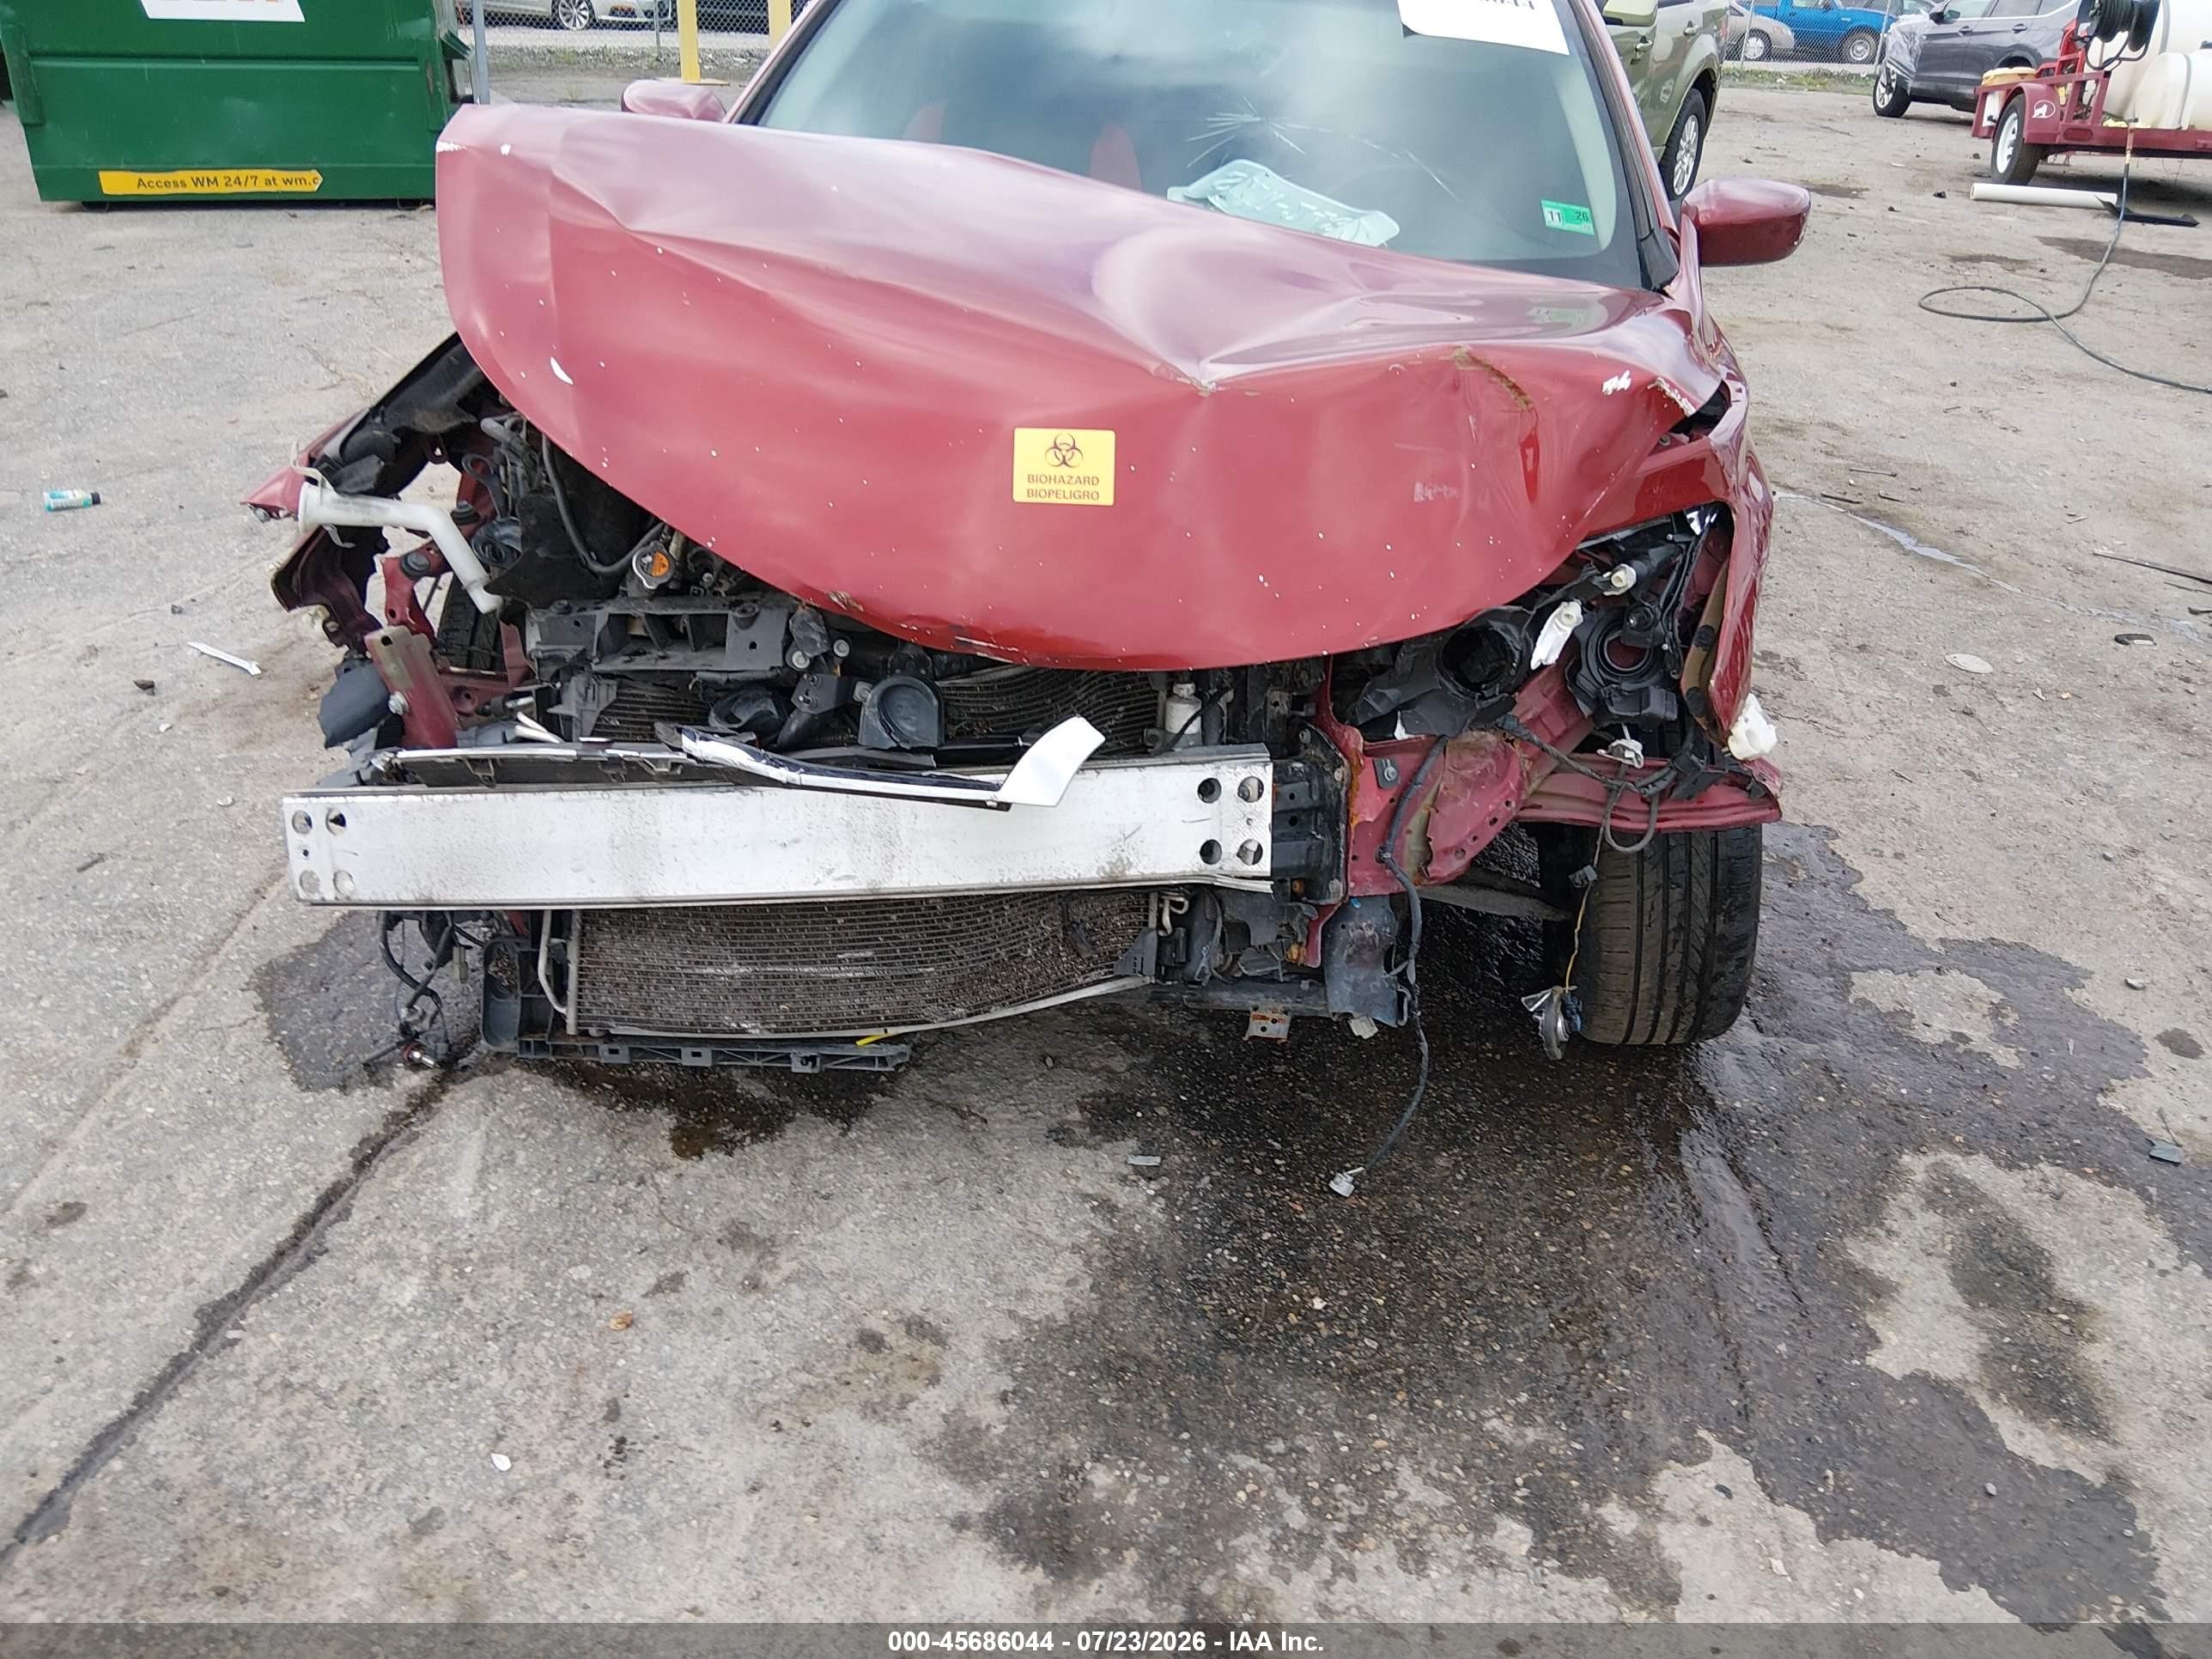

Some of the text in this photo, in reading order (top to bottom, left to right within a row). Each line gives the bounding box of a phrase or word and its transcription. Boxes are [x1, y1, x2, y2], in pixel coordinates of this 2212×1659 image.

[137, 177, 187, 189] Access
[191, 176, 220, 187] WM
[224, 175, 258, 187] 24/7
[264, 175, 277, 186] at
[1027, 474, 1100, 487] BIOHAZARD
[1026, 488, 1100, 501] BIOPELIGRO
